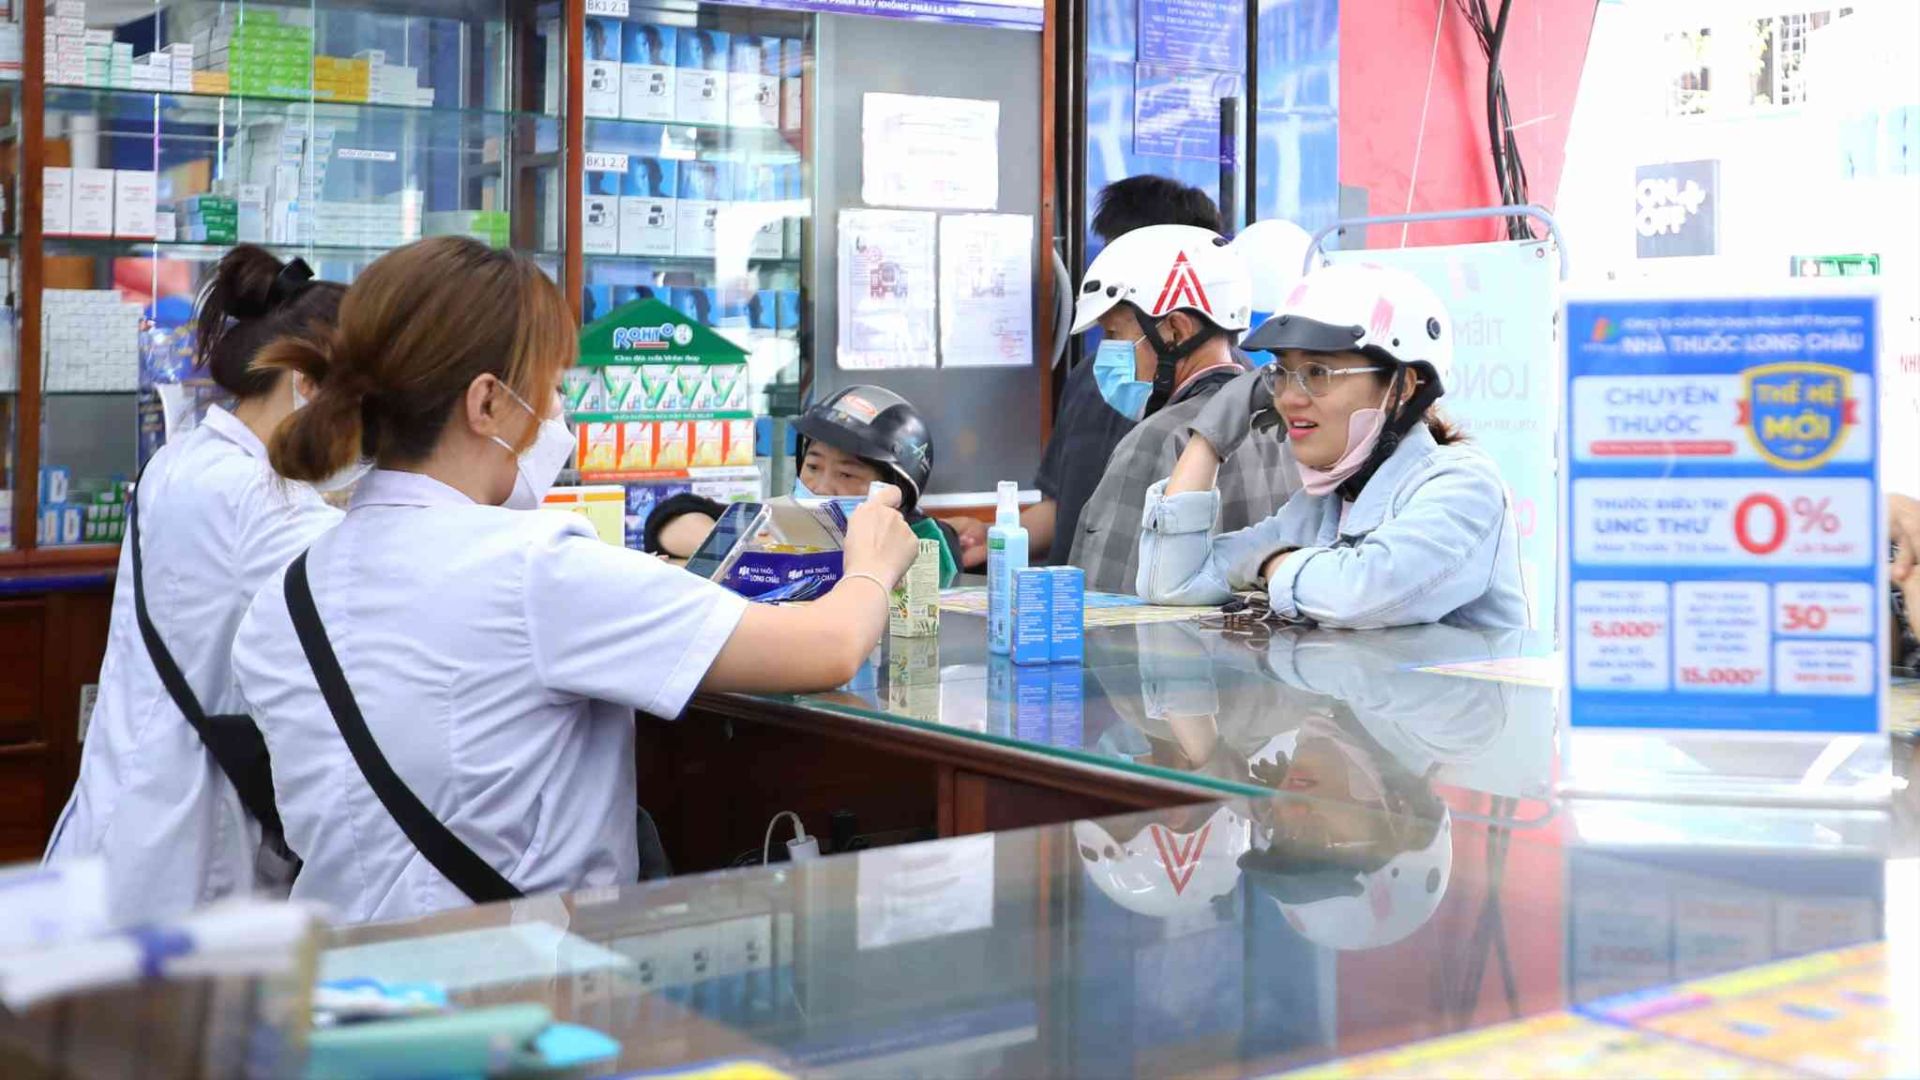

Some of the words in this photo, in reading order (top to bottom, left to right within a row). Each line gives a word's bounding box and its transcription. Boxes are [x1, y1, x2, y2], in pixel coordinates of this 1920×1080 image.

[613, 322, 675, 349] ROHTO
[1622, 334, 1666, 353] NHÀ
[1672, 331, 1739, 353] THUỐC
[1746, 334, 1800, 353] LONG
[1805, 329, 1864, 351] CHÂU
[1781, 603, 1828, 631] 30
